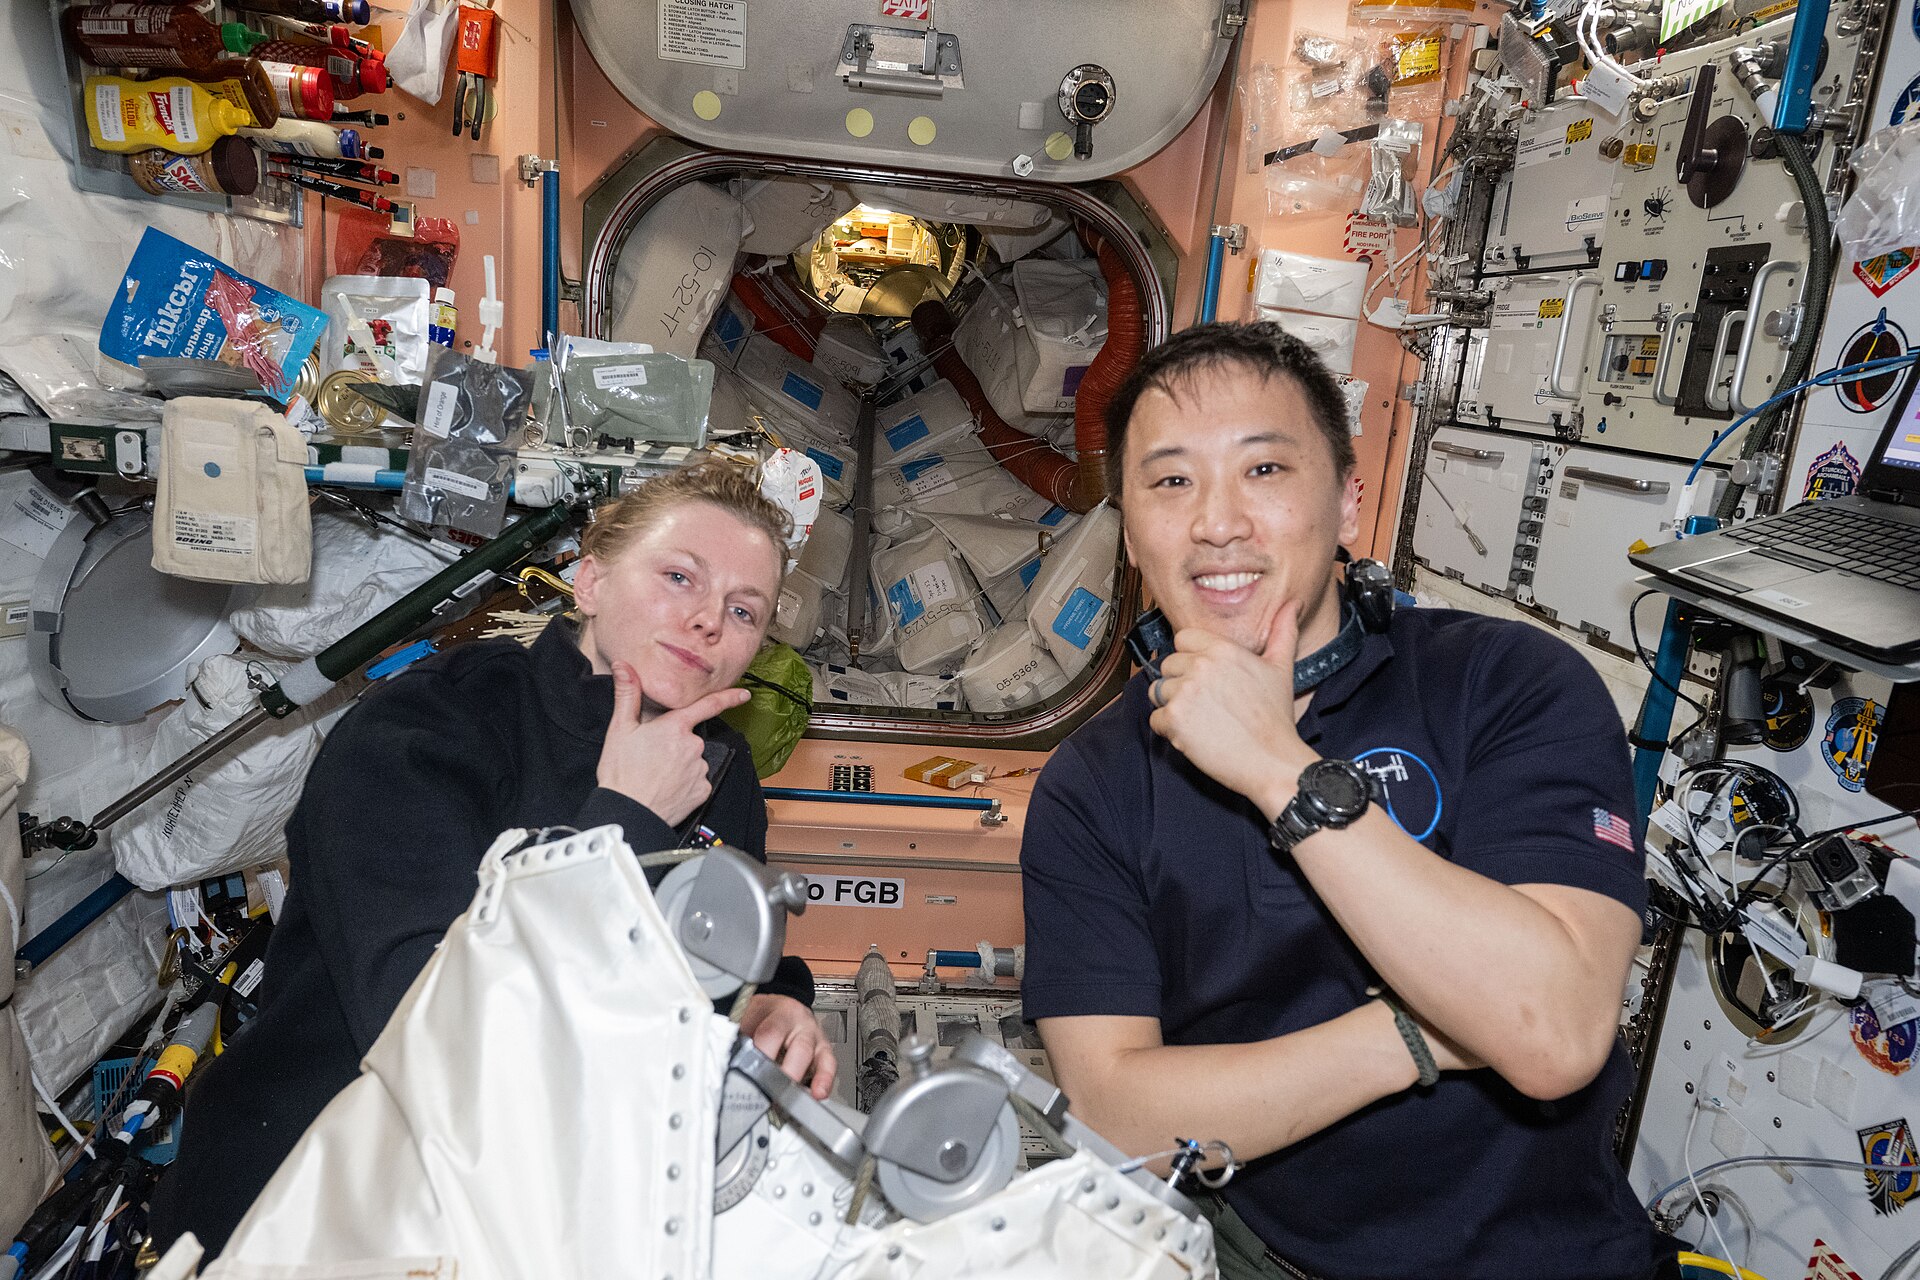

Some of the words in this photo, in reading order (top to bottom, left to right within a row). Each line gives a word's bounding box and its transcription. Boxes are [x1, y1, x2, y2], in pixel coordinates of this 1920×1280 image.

[708, 1, 734, 10] HATCH
[1755, 8, 1773, 17] Caution:
[125, 98, 137, 127] YELLOW
[154, 94, 174, 131] French's
[1520, 138, 1535, 146] FRIDGE
[1859, 271, 1874, 288] OCHOA
[144, 270, 199, 349] Тиксы
[433, 417, 441, 428] Hint
[437, 391, 448, 410] Orange
[798, 476, 813, 485] HUGGIES
[1817, 473, 1850, 481] ARCHAMBAULT
[176, 537, 213, 545] BOEING
[1063, 614, 1076, 630] HYGIENE
[1074, 598, 1085, 614] TOWEL
[1764, 693, 1777, 702] 127
[1825, 749, 1837, 770] OLIVAS
[806, 883, 824, 900] o
[835, 880, 899, 904] FGB
[1888, 1030, 1905, 1046] 133
[1860, 1126, 1882, 1136] FERGUSON
[1884, 1121, 1903, 1129] HURLEY
